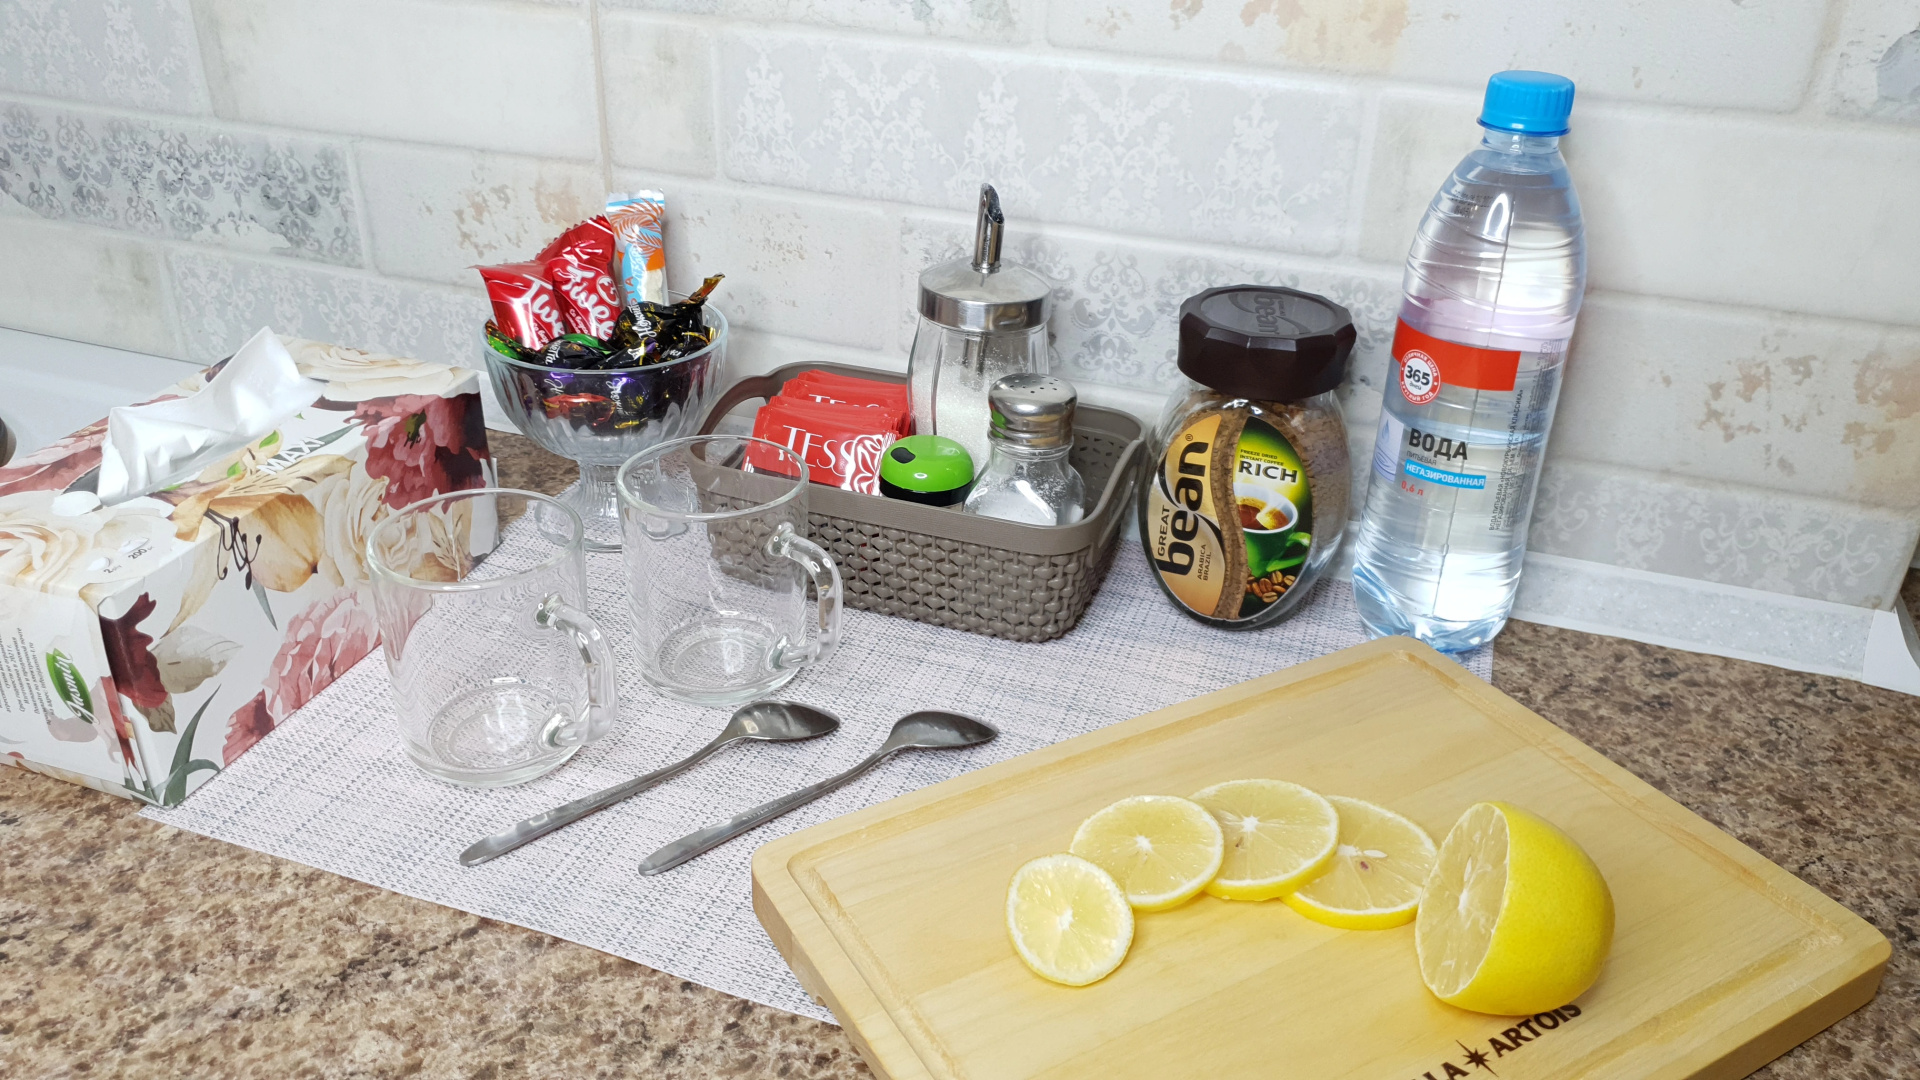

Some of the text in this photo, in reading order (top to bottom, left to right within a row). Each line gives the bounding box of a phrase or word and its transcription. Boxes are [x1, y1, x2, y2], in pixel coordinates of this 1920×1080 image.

[1405, 365, 1430, 386] 365
[1422, 391, 1434, 400] ГОД
[256, 437, 325, 475] MAXI
[1240, 449, 1261, 457] FREEZE
[1240, 454, 1262, 462] INSTANT
[1406, 450, 1437, 466] ПИТЬЕВАЯ
[1409, 428, 1468, 461] ВОДА
[1238, 460, 1298, 483] RICH
[1406, 463, 1485, 487] НЕГАЗИРОВАННАЯ
[1401, 480, 1415, 493] 0,6
[1155, 441, 1210, 576] bean
[1157, 505, 1170, 557] GREAT
[1197, 544, 1206, 580] ARABICA
[1203, 551, 1212, 581] BRAZIL
[55, 652, 100, 725] Jasmin
[1488, 1004, 1582, 1058] ARTOIS
